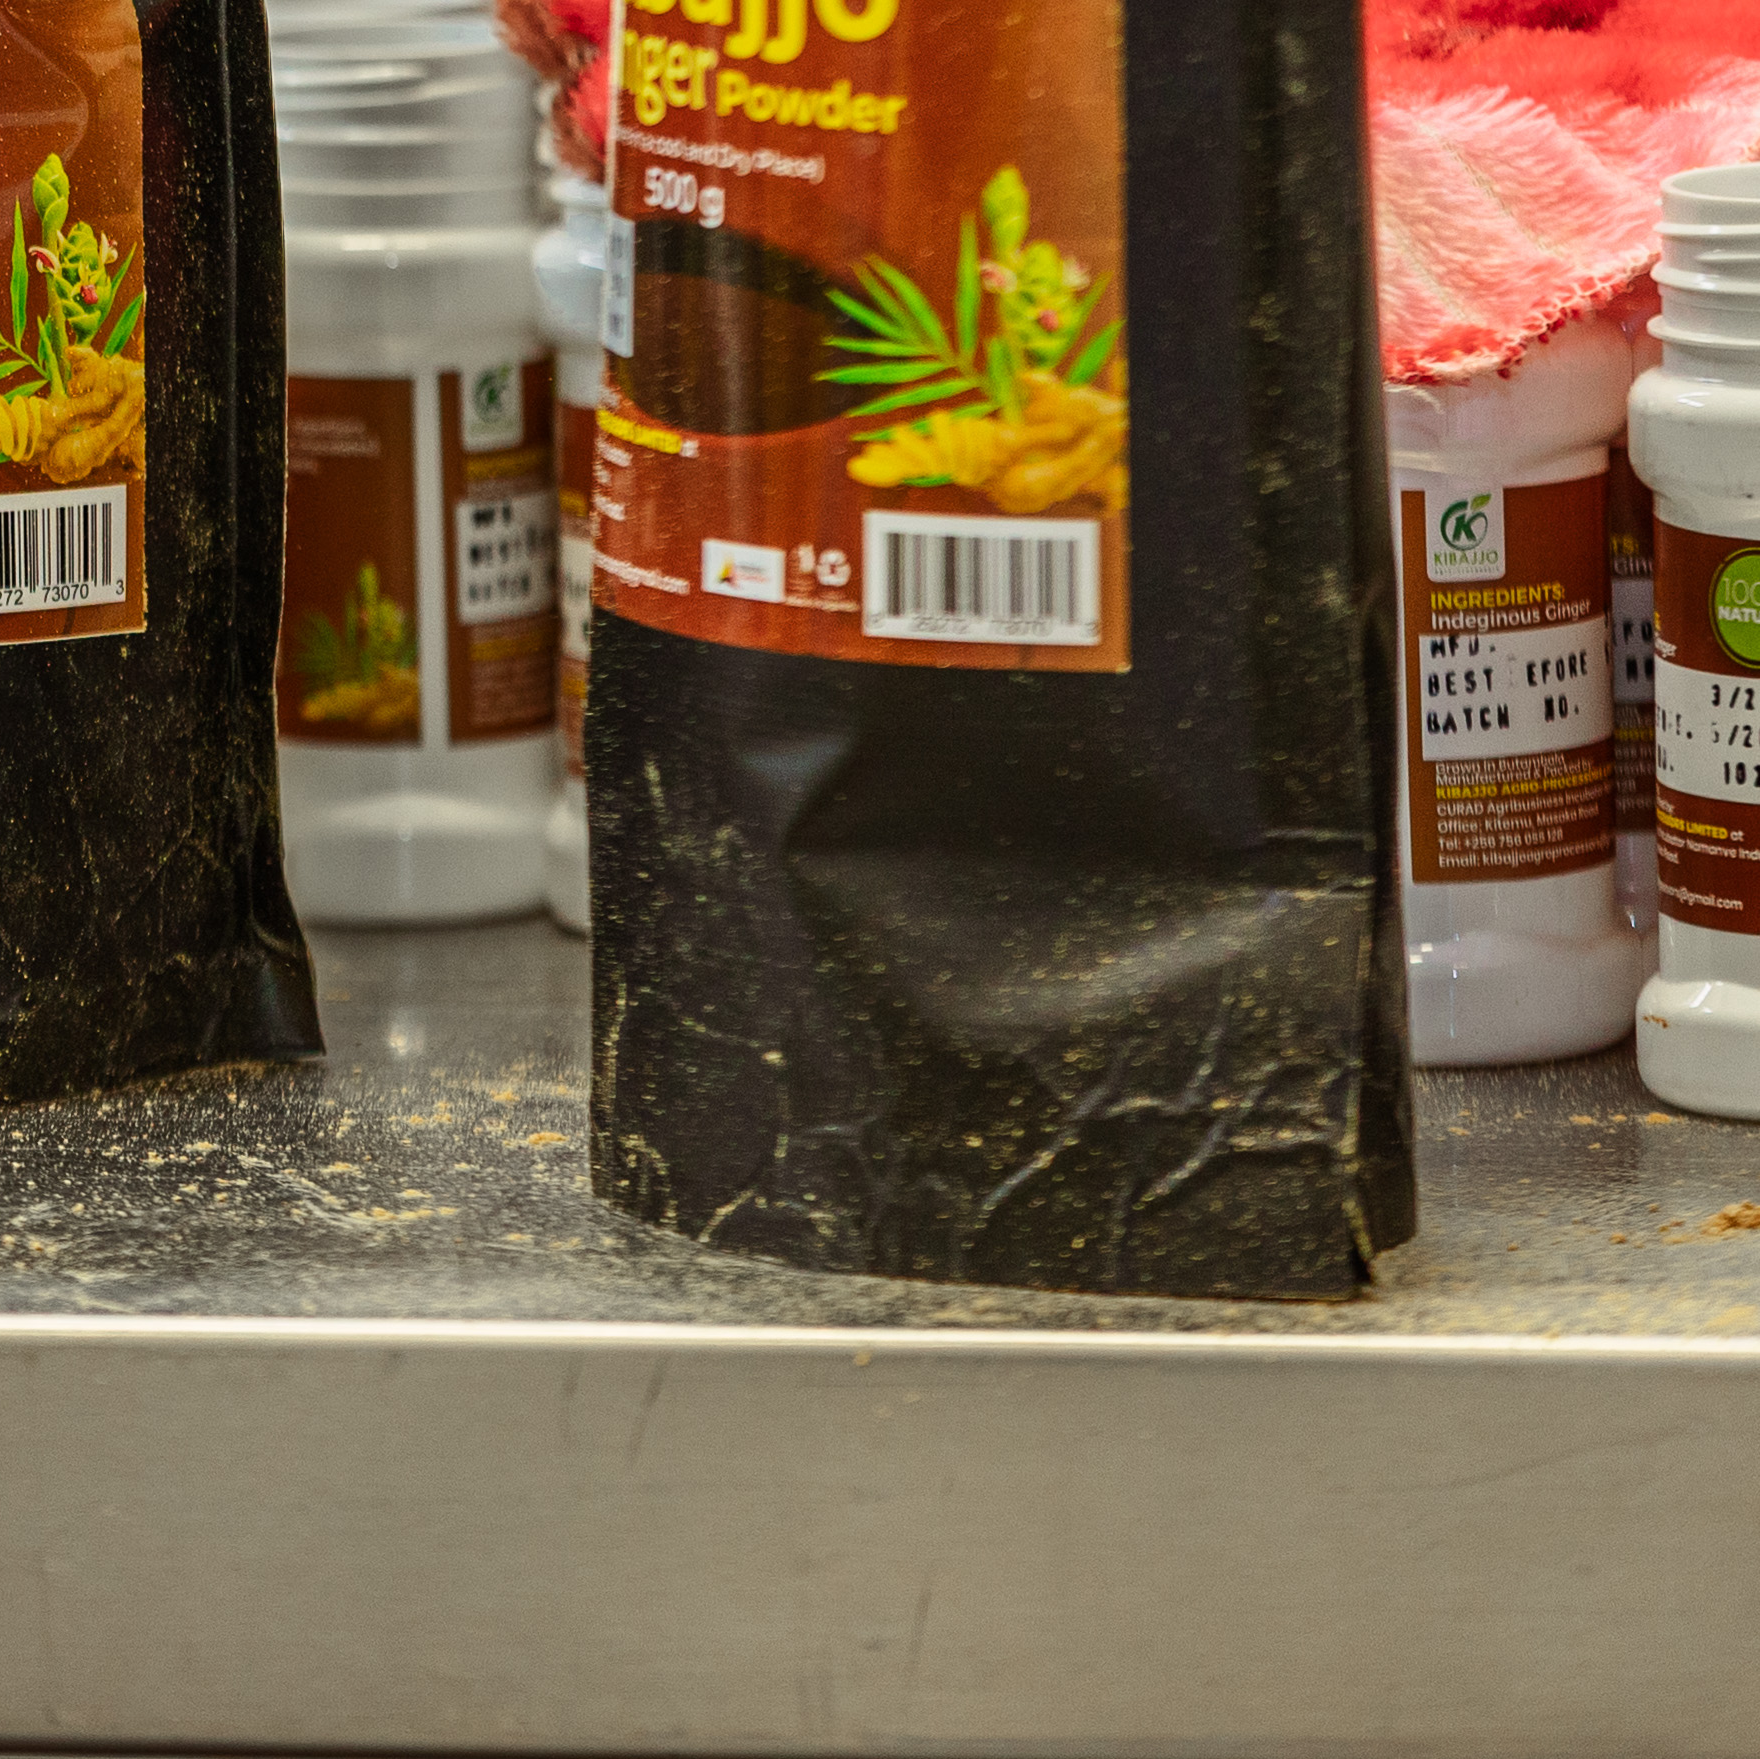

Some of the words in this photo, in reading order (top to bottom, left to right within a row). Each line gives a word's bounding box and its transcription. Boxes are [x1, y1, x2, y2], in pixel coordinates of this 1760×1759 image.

[716, 69, 908, 134] Powder
[644, 166, 698, 214] 500
[1433, 550, 1499, 567] KIBAJJO
[42, 583, 89, 603] 73070
[115, 579, 125, 596] 3
[1431, 607, 1541, 632] Indeginous
[1545, 598, 1592, 622] Ginger
[1428, 667, 1494, 697] BEST
[1427, 703, 1510, 735] BATCH
